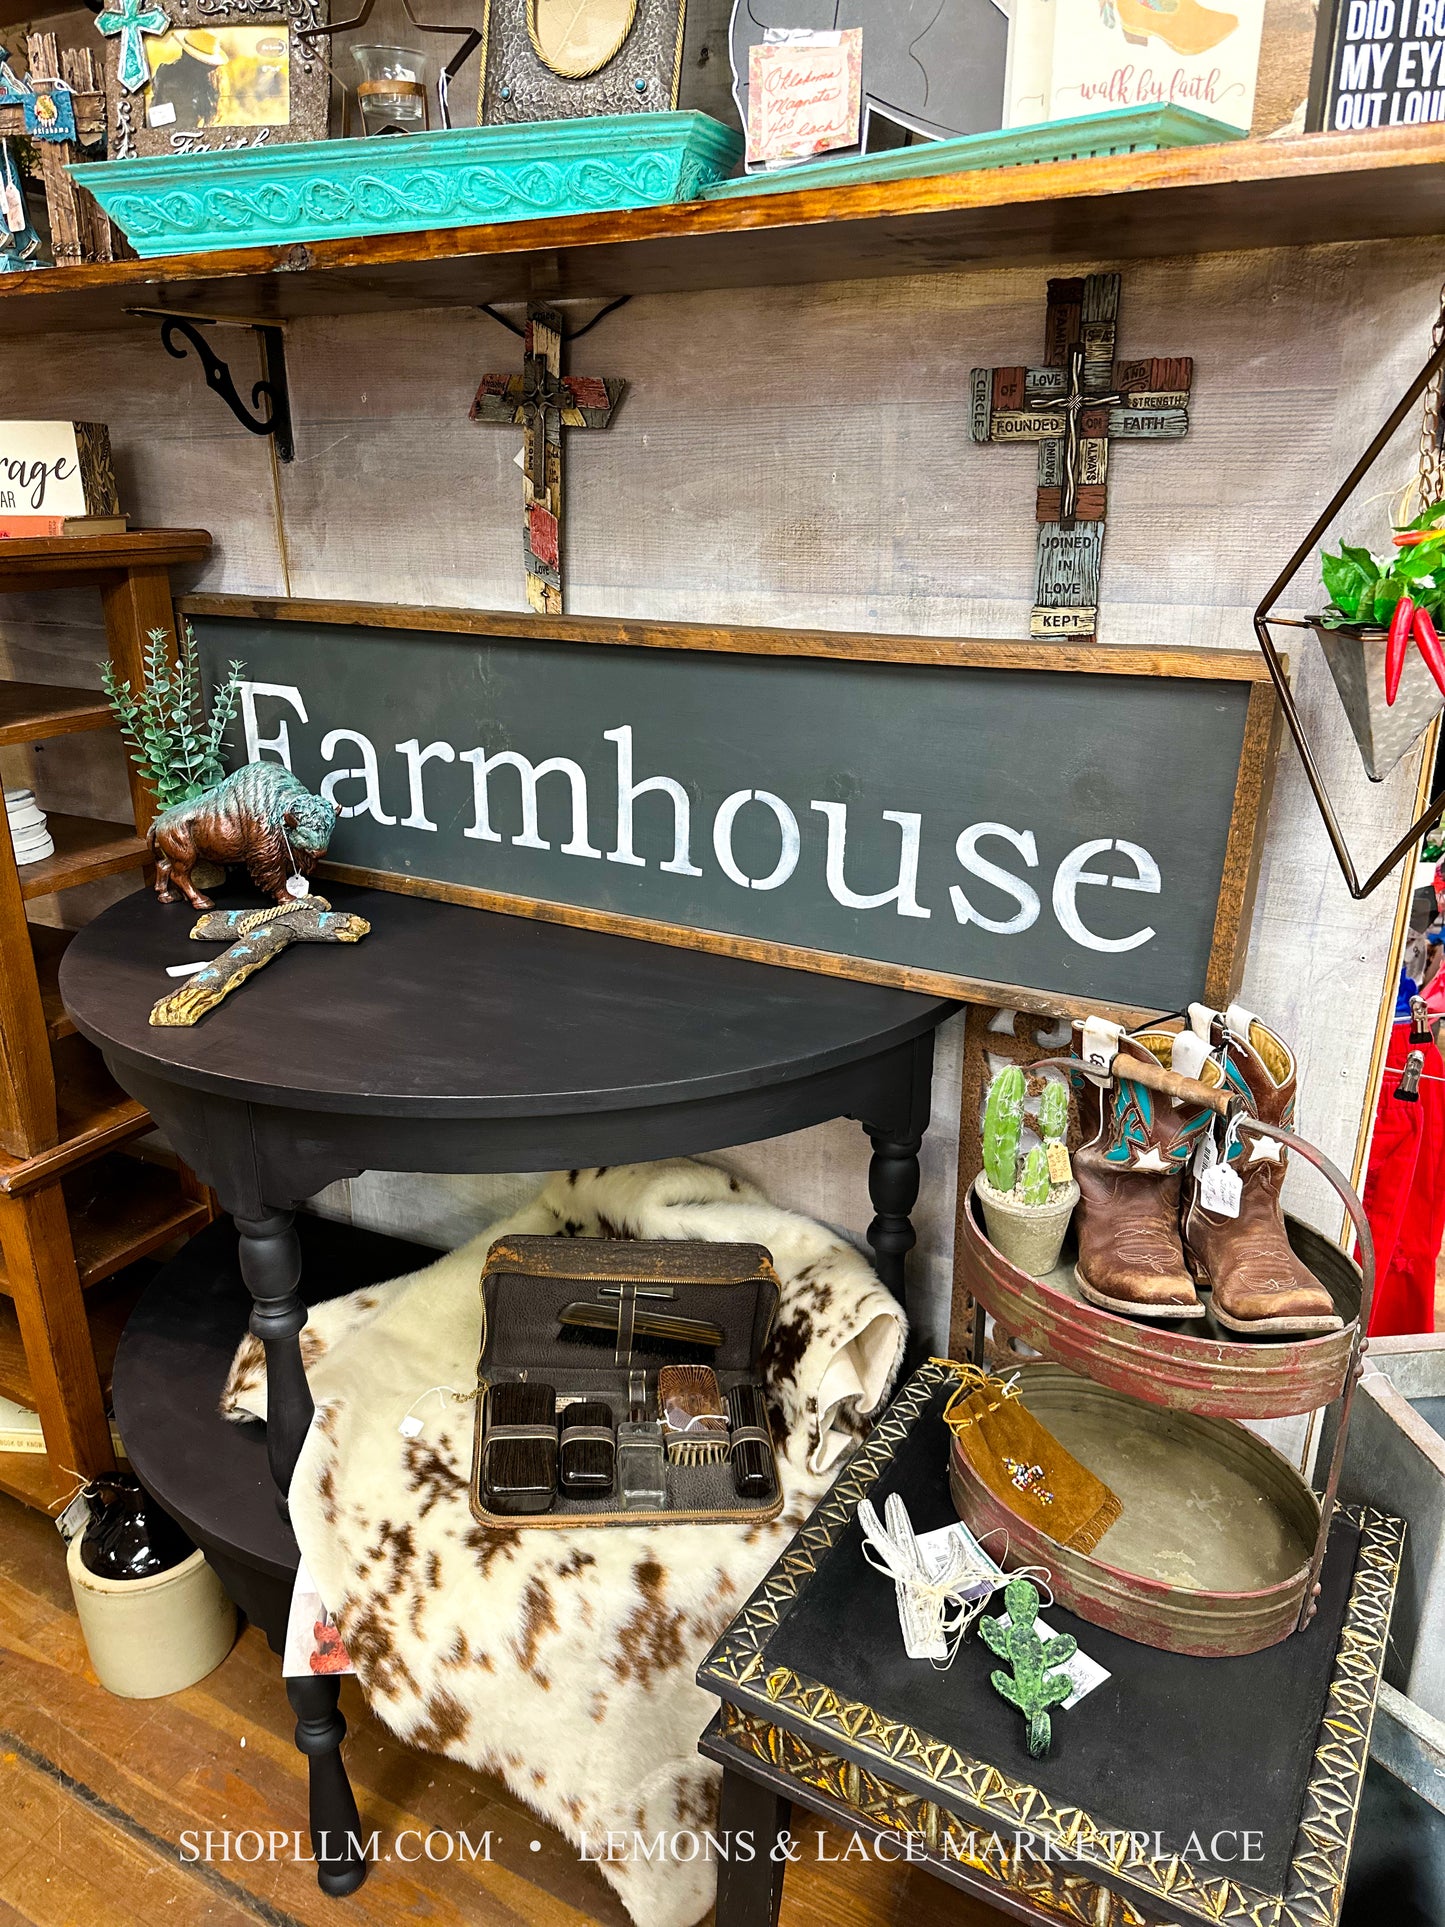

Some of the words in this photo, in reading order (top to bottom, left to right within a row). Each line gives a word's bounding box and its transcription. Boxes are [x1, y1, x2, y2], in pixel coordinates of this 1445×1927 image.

[1346, 0, 1396, 40] DID
[1399, 0, 1411, 38] I
[1339, 42, 1394, 90] MY
[1060, 64, 1134, 104] walk
[1136, 69, 1167, 103] by
[1169, 68, 1242, 104] faith
[1335, 92, 1388, 131] OUT
[1032, 373, 1062, 387] LOVE
[1122, 367, 1146, 383] AND
[1000, 384, 1017, 397] OF
[975, 380, 986, 428] CIRCLE
[1131, 394, 1183, 408] STRENGTH
[996, 418, 1060, 433] FOUNDED
[1123, 416, 1166, 431] FAITH
[1044, 441, 1056, 485] PRAYING
[1086, 441, 1098, 481] ALWAYS
[1041, 536, 1092, 550] JOINED
[1058, 560, 1072, 571] IN
[1044, 583, 1081, 594] LOVE
[1043, 615, 1080, 627] KEPT
[232, 679, 1162, 953] Farmhouse
